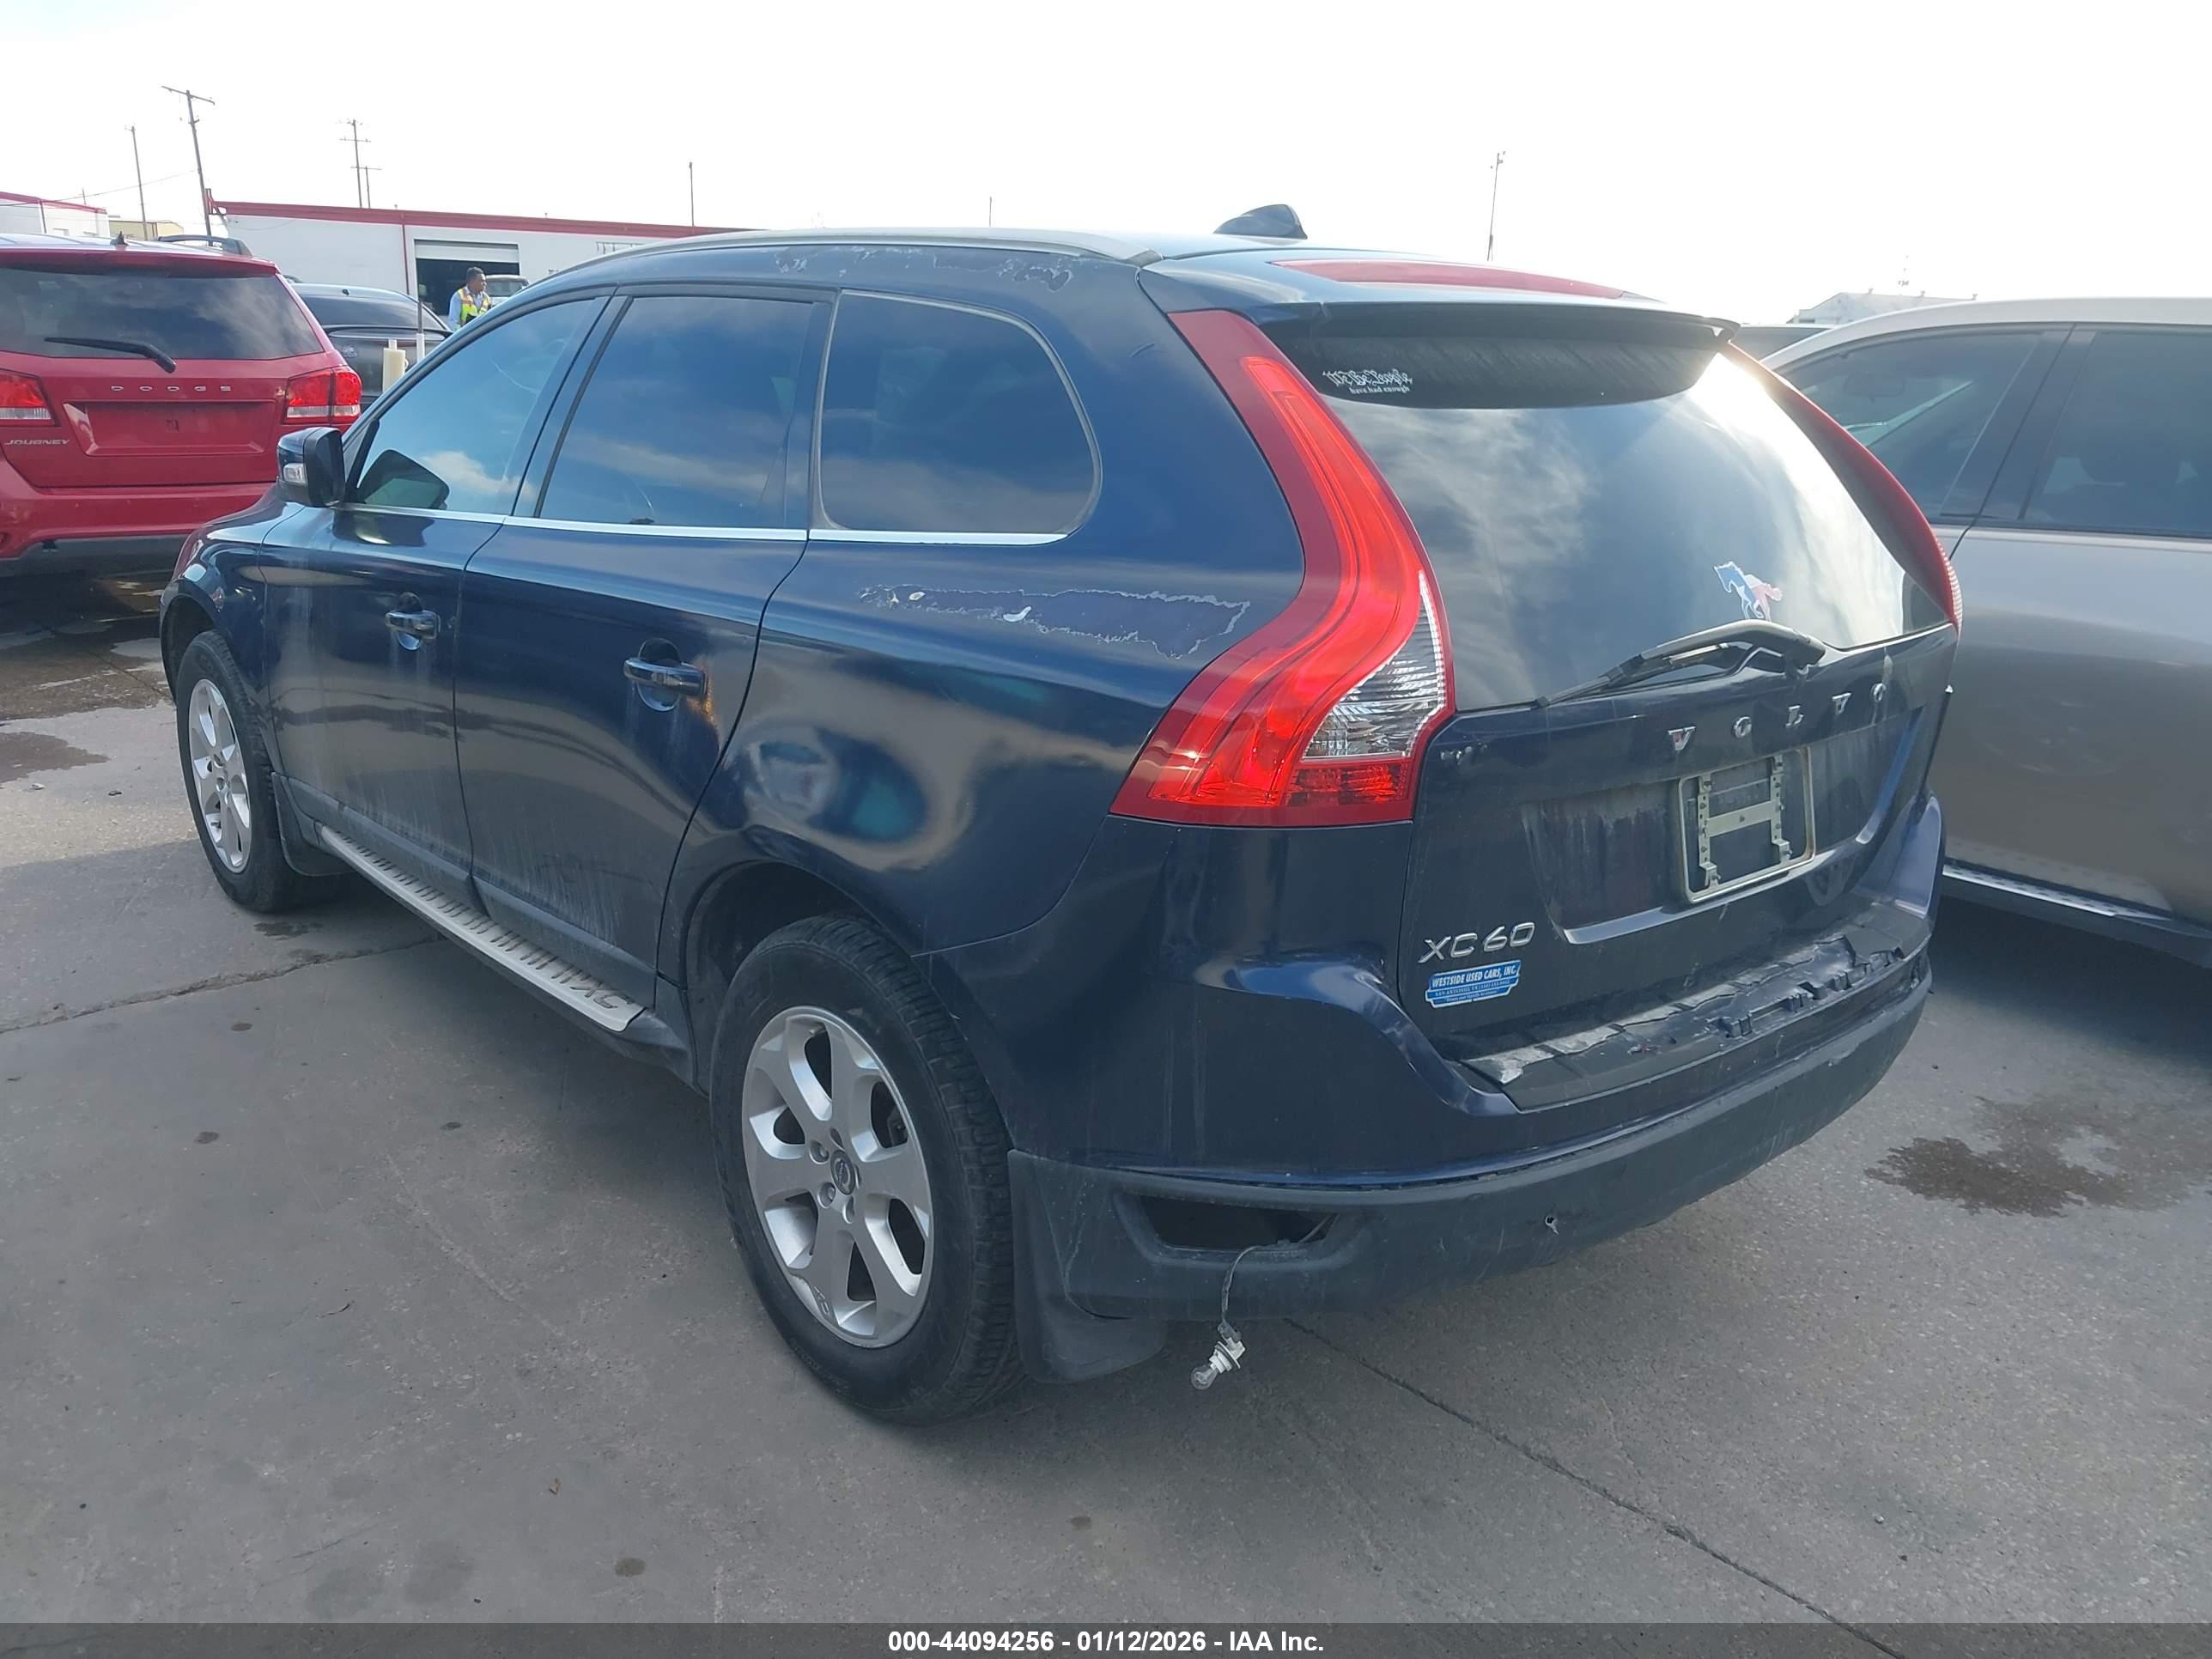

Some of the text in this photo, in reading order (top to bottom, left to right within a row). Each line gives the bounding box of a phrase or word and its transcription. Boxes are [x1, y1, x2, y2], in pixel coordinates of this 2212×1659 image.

[1383, 385, 1410, 393] enough
[1668, 683, 1887, 751] VOLVO
[1432, 975, 1465, 988] WESTSIDE
[1466, 972, 1483, 983] USED
[1484, 968, 1502, 980] CARS,
